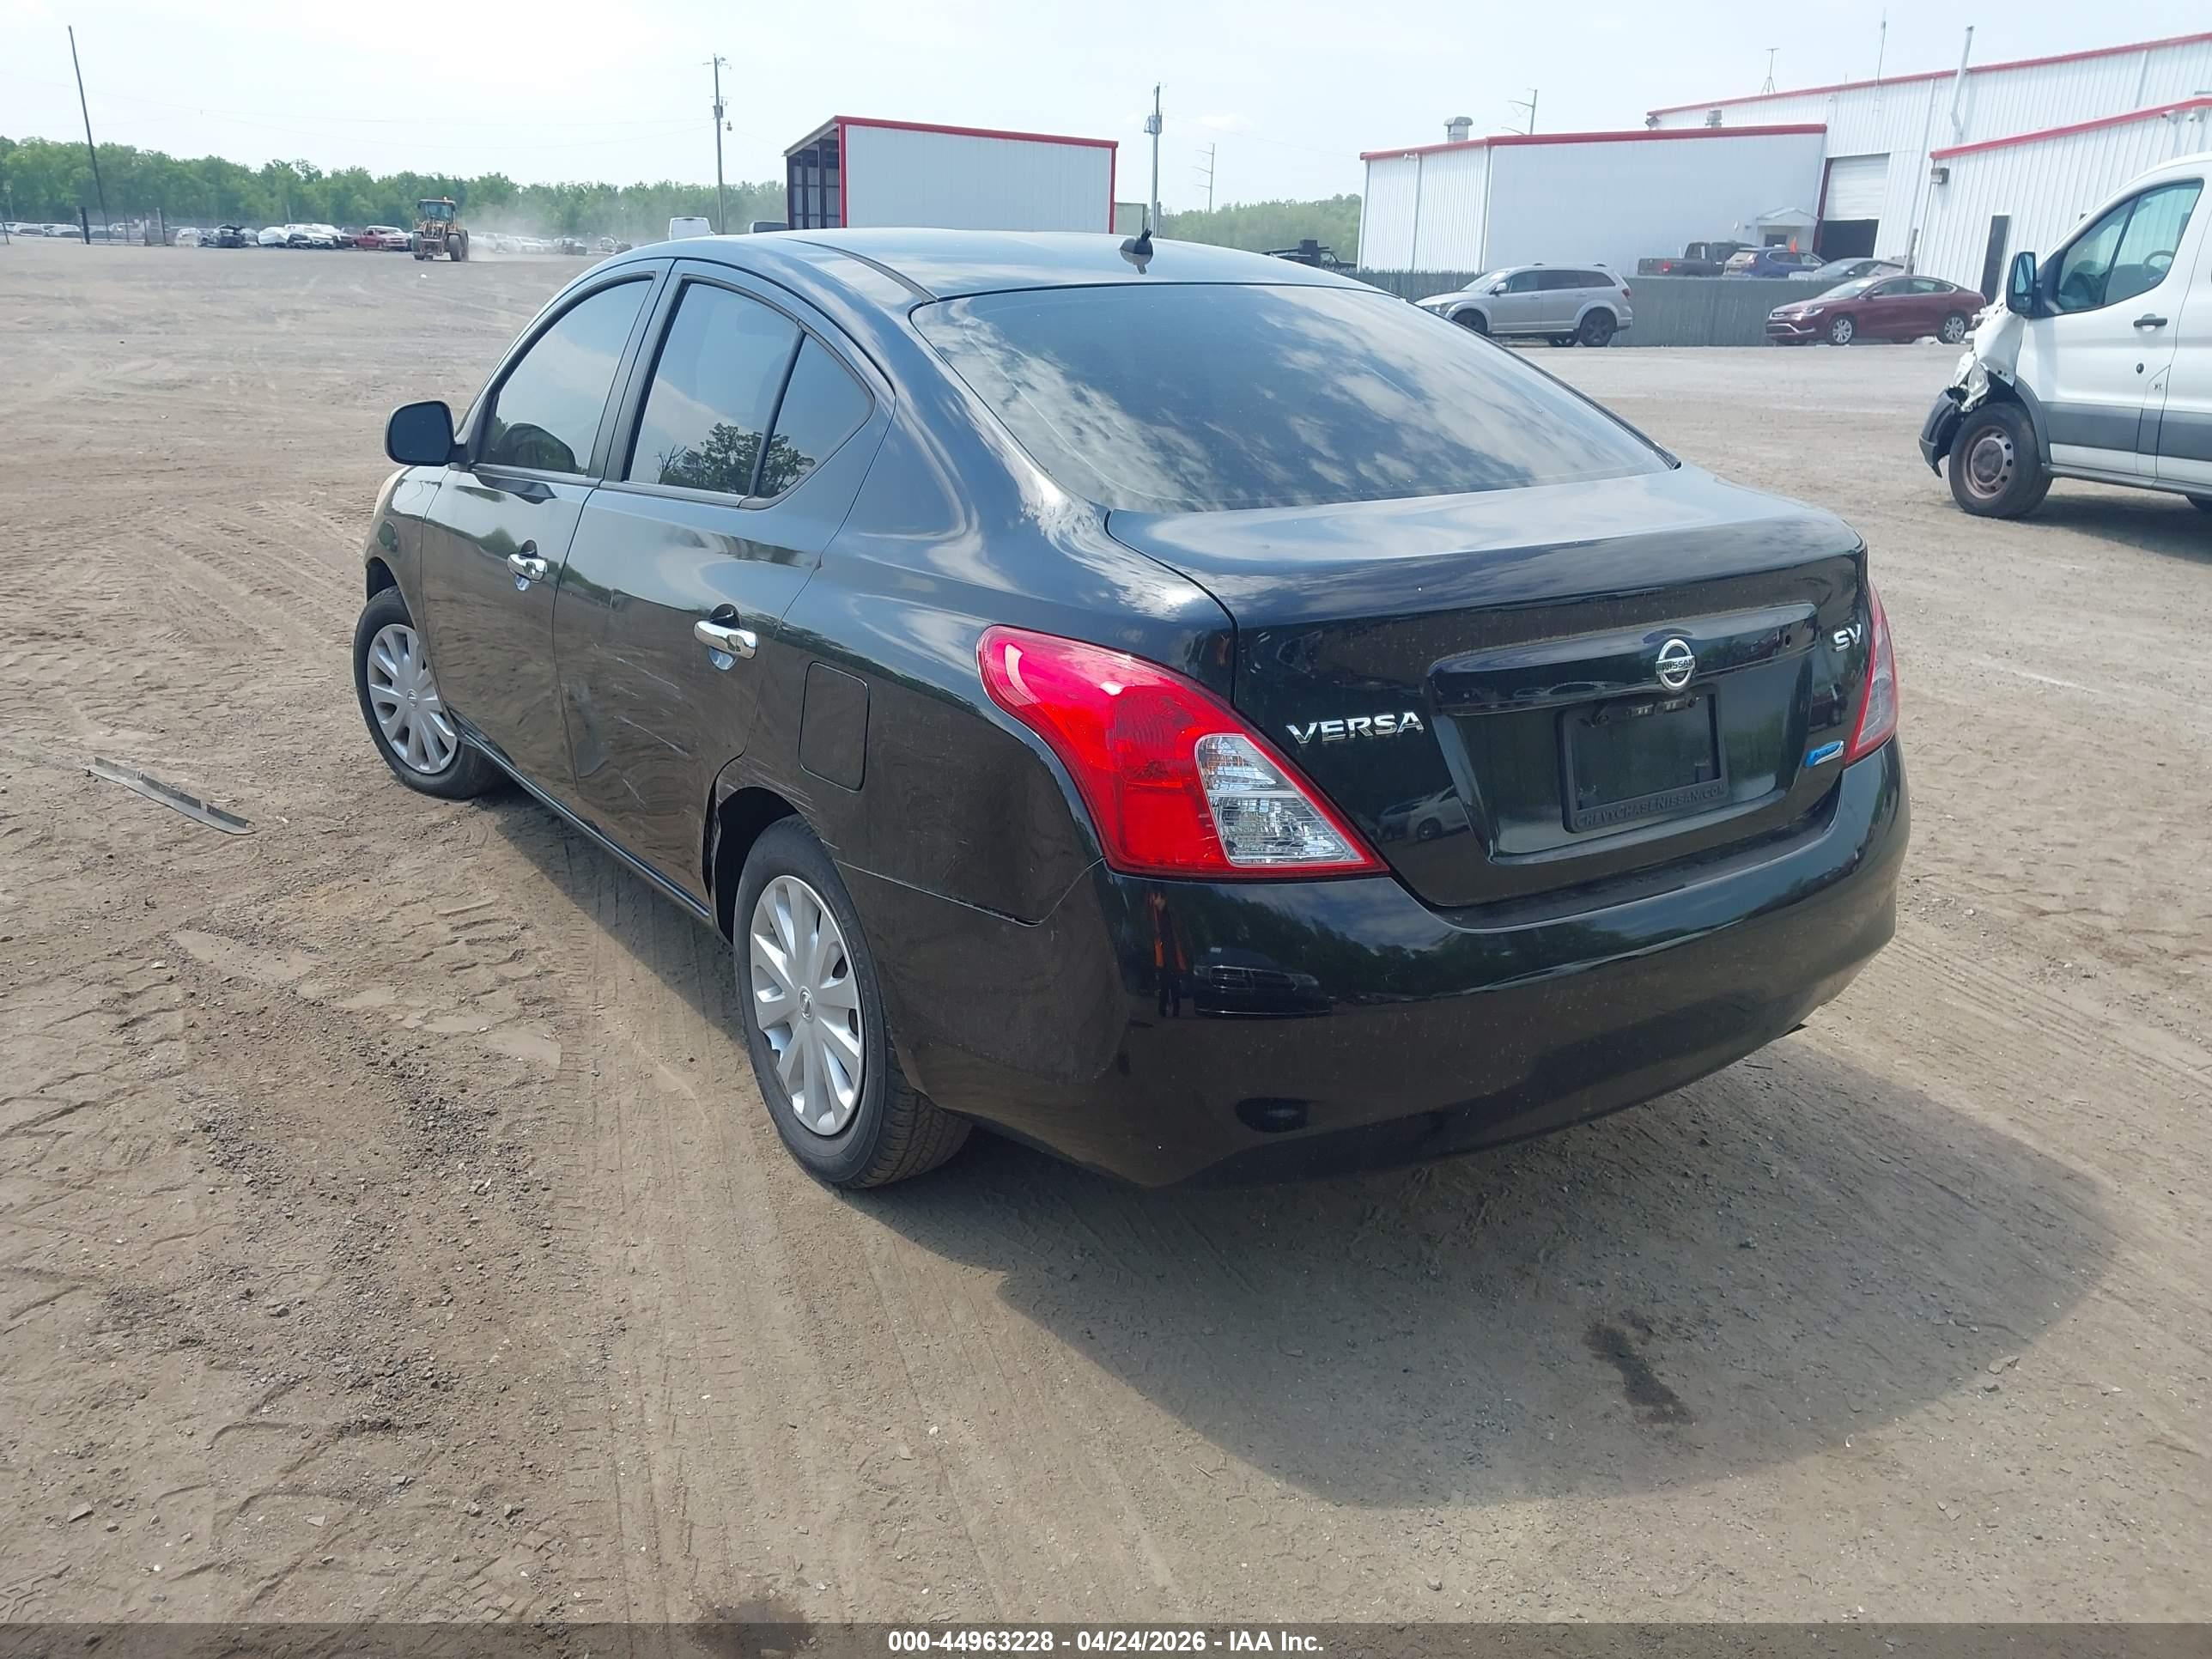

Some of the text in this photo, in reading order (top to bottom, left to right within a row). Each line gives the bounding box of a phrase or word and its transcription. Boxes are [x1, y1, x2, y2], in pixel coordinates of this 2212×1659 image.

[1834, 623, 1862, 652] SV
[1662, 657, 1696, 671] NISSAN
[1285, 711, 1425, 744] VERSA
